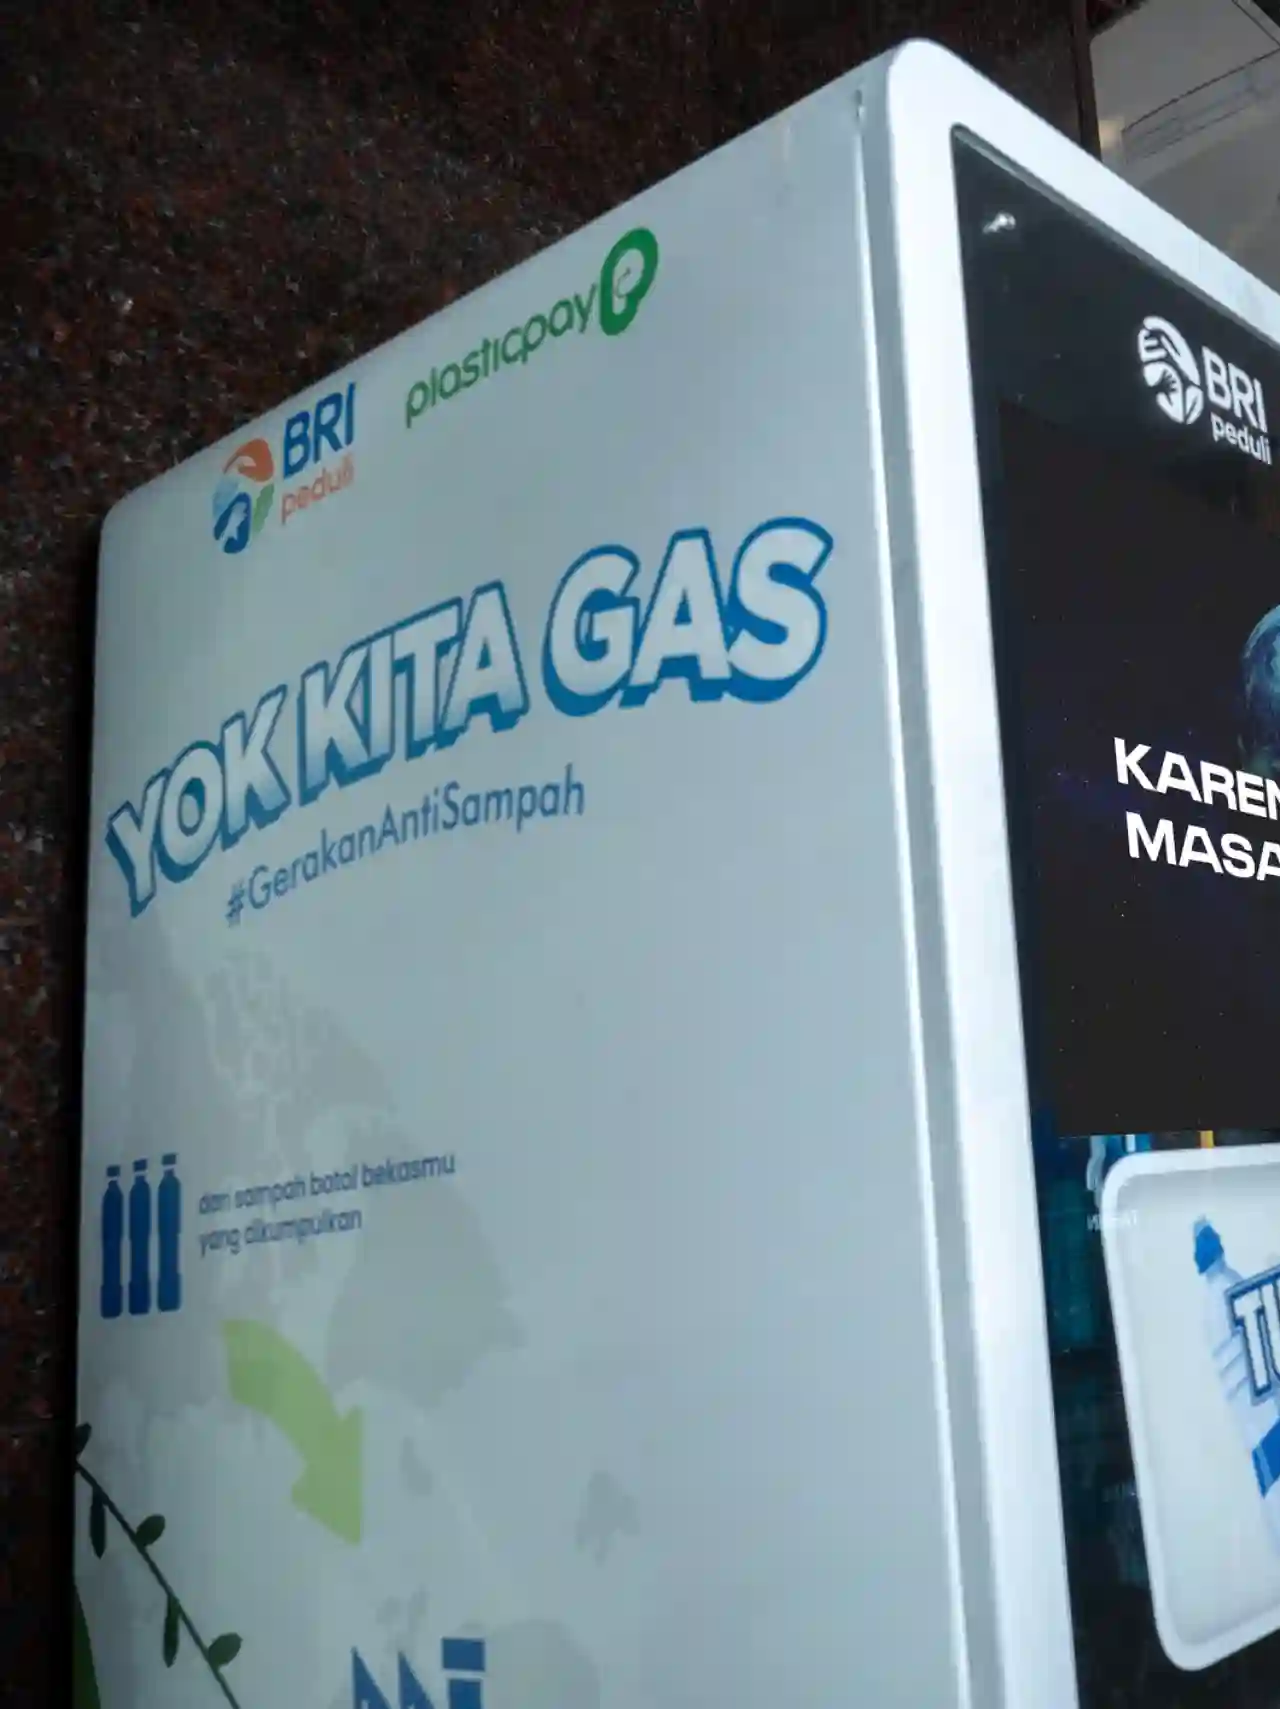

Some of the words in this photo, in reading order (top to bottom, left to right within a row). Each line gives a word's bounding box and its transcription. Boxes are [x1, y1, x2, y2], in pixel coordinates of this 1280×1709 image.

[406, 284, 597, 428] plasticpay
[1202, 346, 1267, 433] BRI
[283, 382, 355, 479] BRI
[1211, 413, 1272, 465] peduli
[282, 453, 354, 524] peduli
[106, 685, 288, 917] YOK
[297, 581, 529, 806] KITA
[543, 517, 834, 717] GAS
[225, 764, 585, 927] #GerakanAntiSampah
[235, 1174, 306, 1210] sampah
[310, 1163, 358, 1196] botol
[362, 1153, 455, 1188] bekasmu
[199, 1227, 241, 1257] yang
